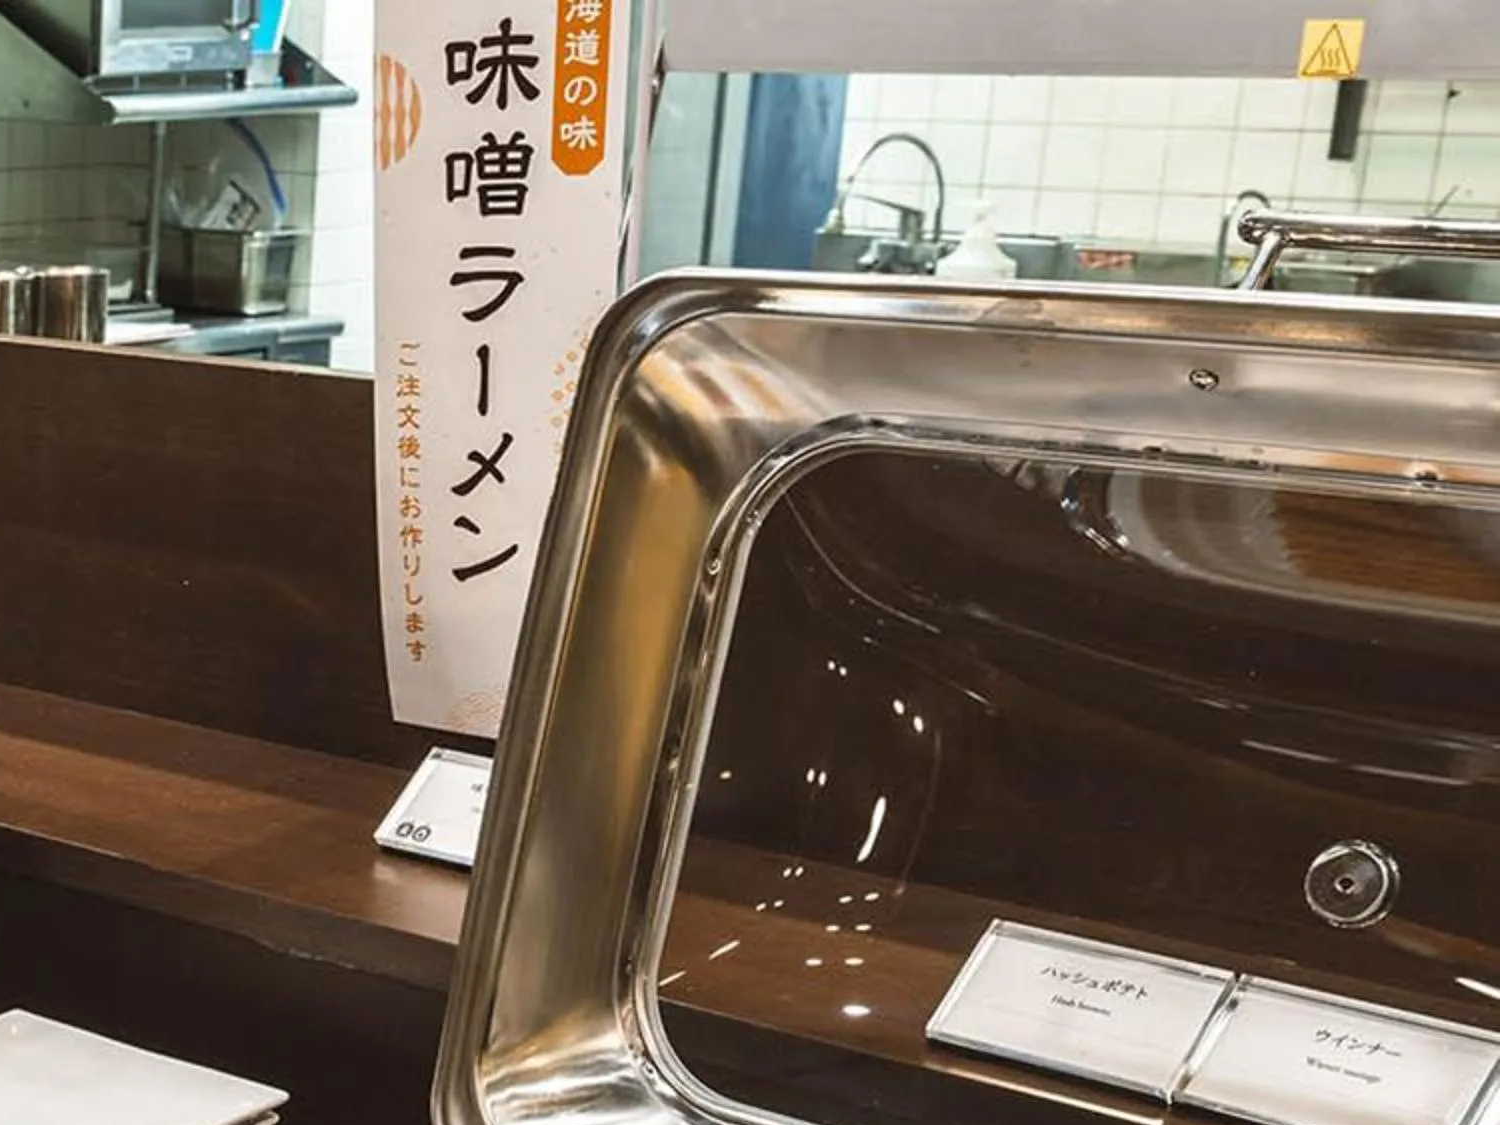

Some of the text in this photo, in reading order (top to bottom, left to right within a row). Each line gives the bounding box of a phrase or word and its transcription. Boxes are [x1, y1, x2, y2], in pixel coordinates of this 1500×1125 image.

[395, 340, 427, 663] ご注文後にお作りします
[443, 16, 542, 583] 味噌ラーメン
